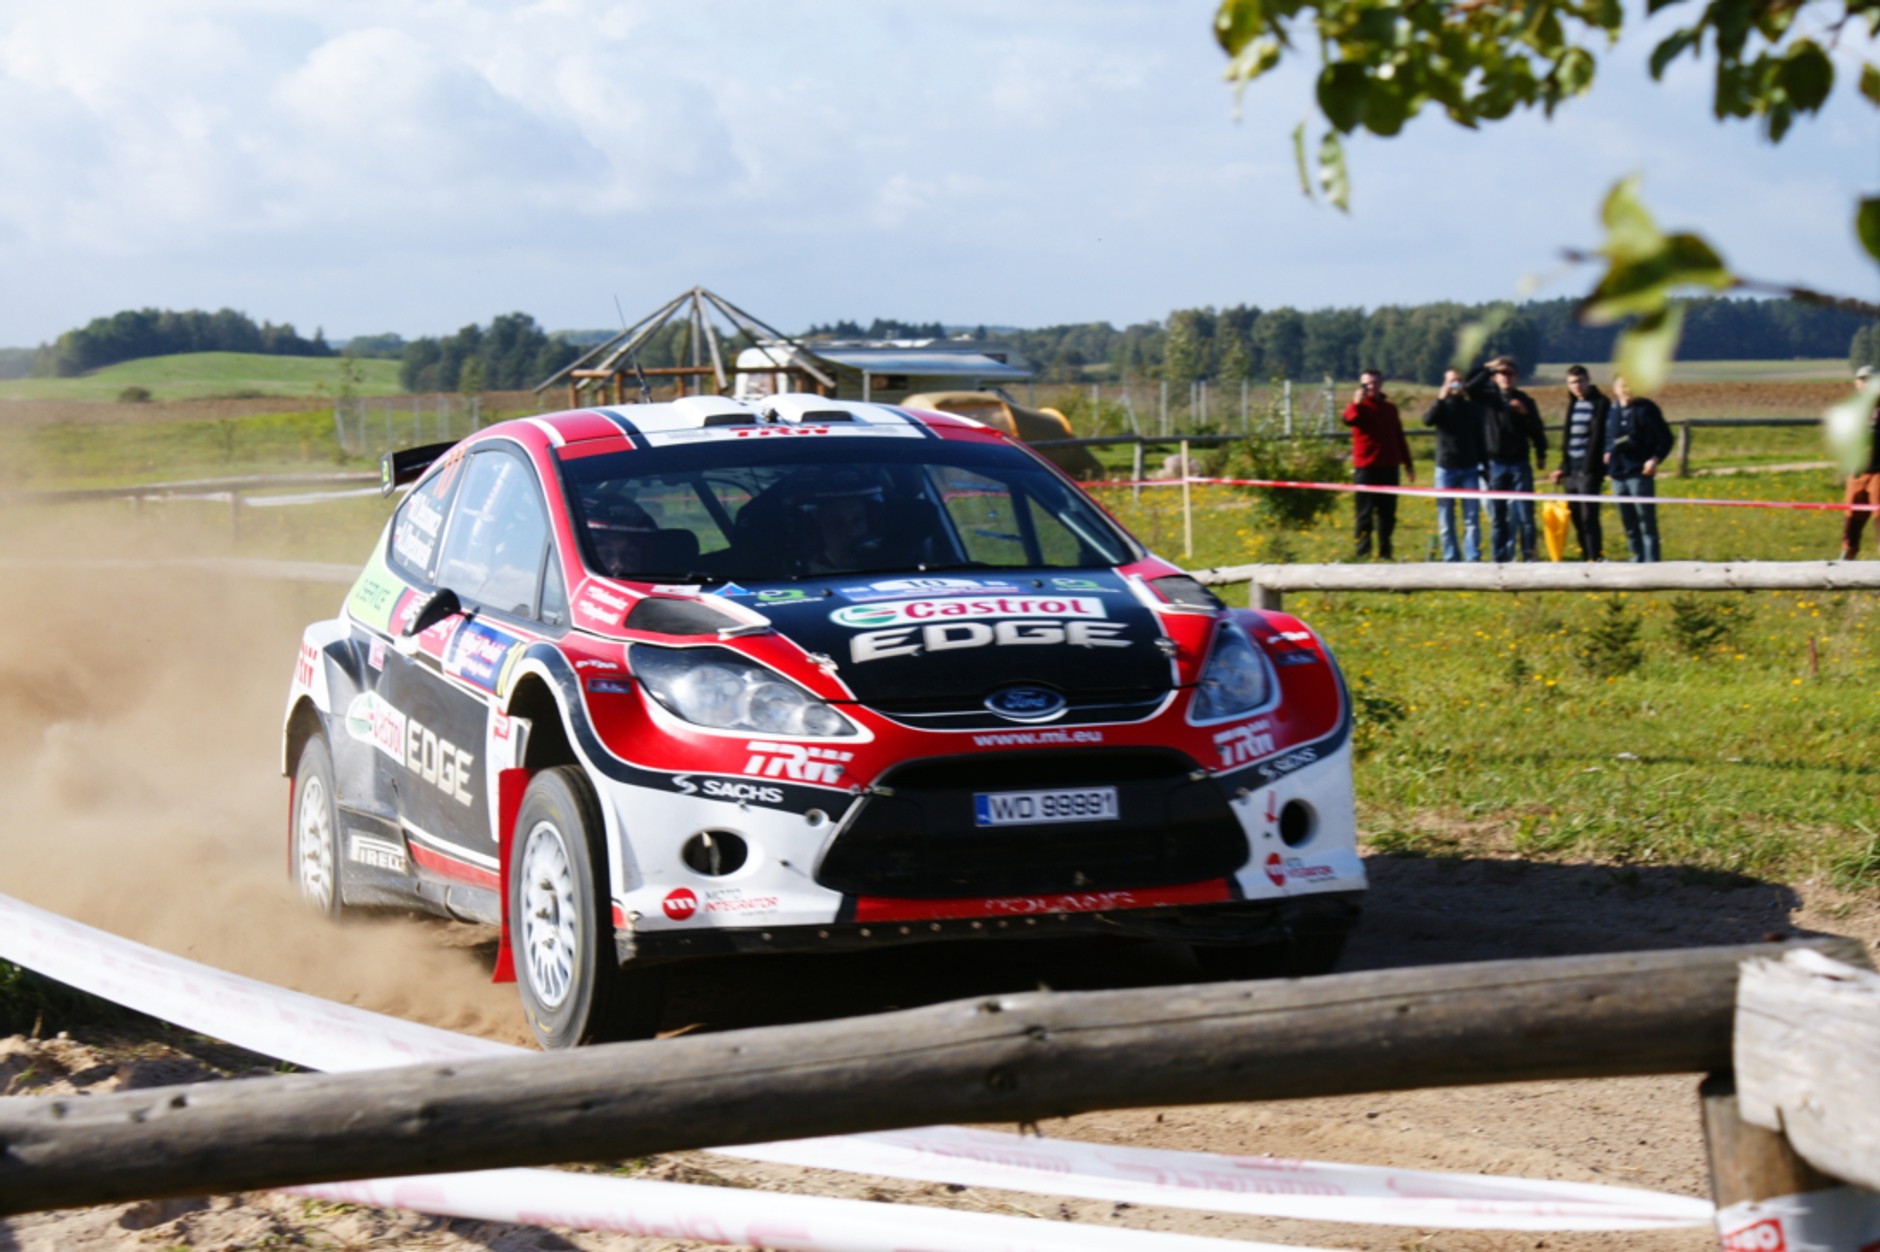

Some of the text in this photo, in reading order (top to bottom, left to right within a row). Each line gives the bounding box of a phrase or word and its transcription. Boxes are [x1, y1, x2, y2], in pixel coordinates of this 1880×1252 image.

[904, 598, 1091, 619] Castrol
[850, 620, 1135, 664] EDGE
[1003, 690, 1047, 709] Ford
[972, 728, 1103, 747] www.mi.eu
[1213, 719, 1276, 767] TRW
[406, 718, 474, 807] EDGE
[743, 740, 855, 784] TRW
[702, 779, 784, 803] SACHS
[990, 796, 1034, 819] WD
